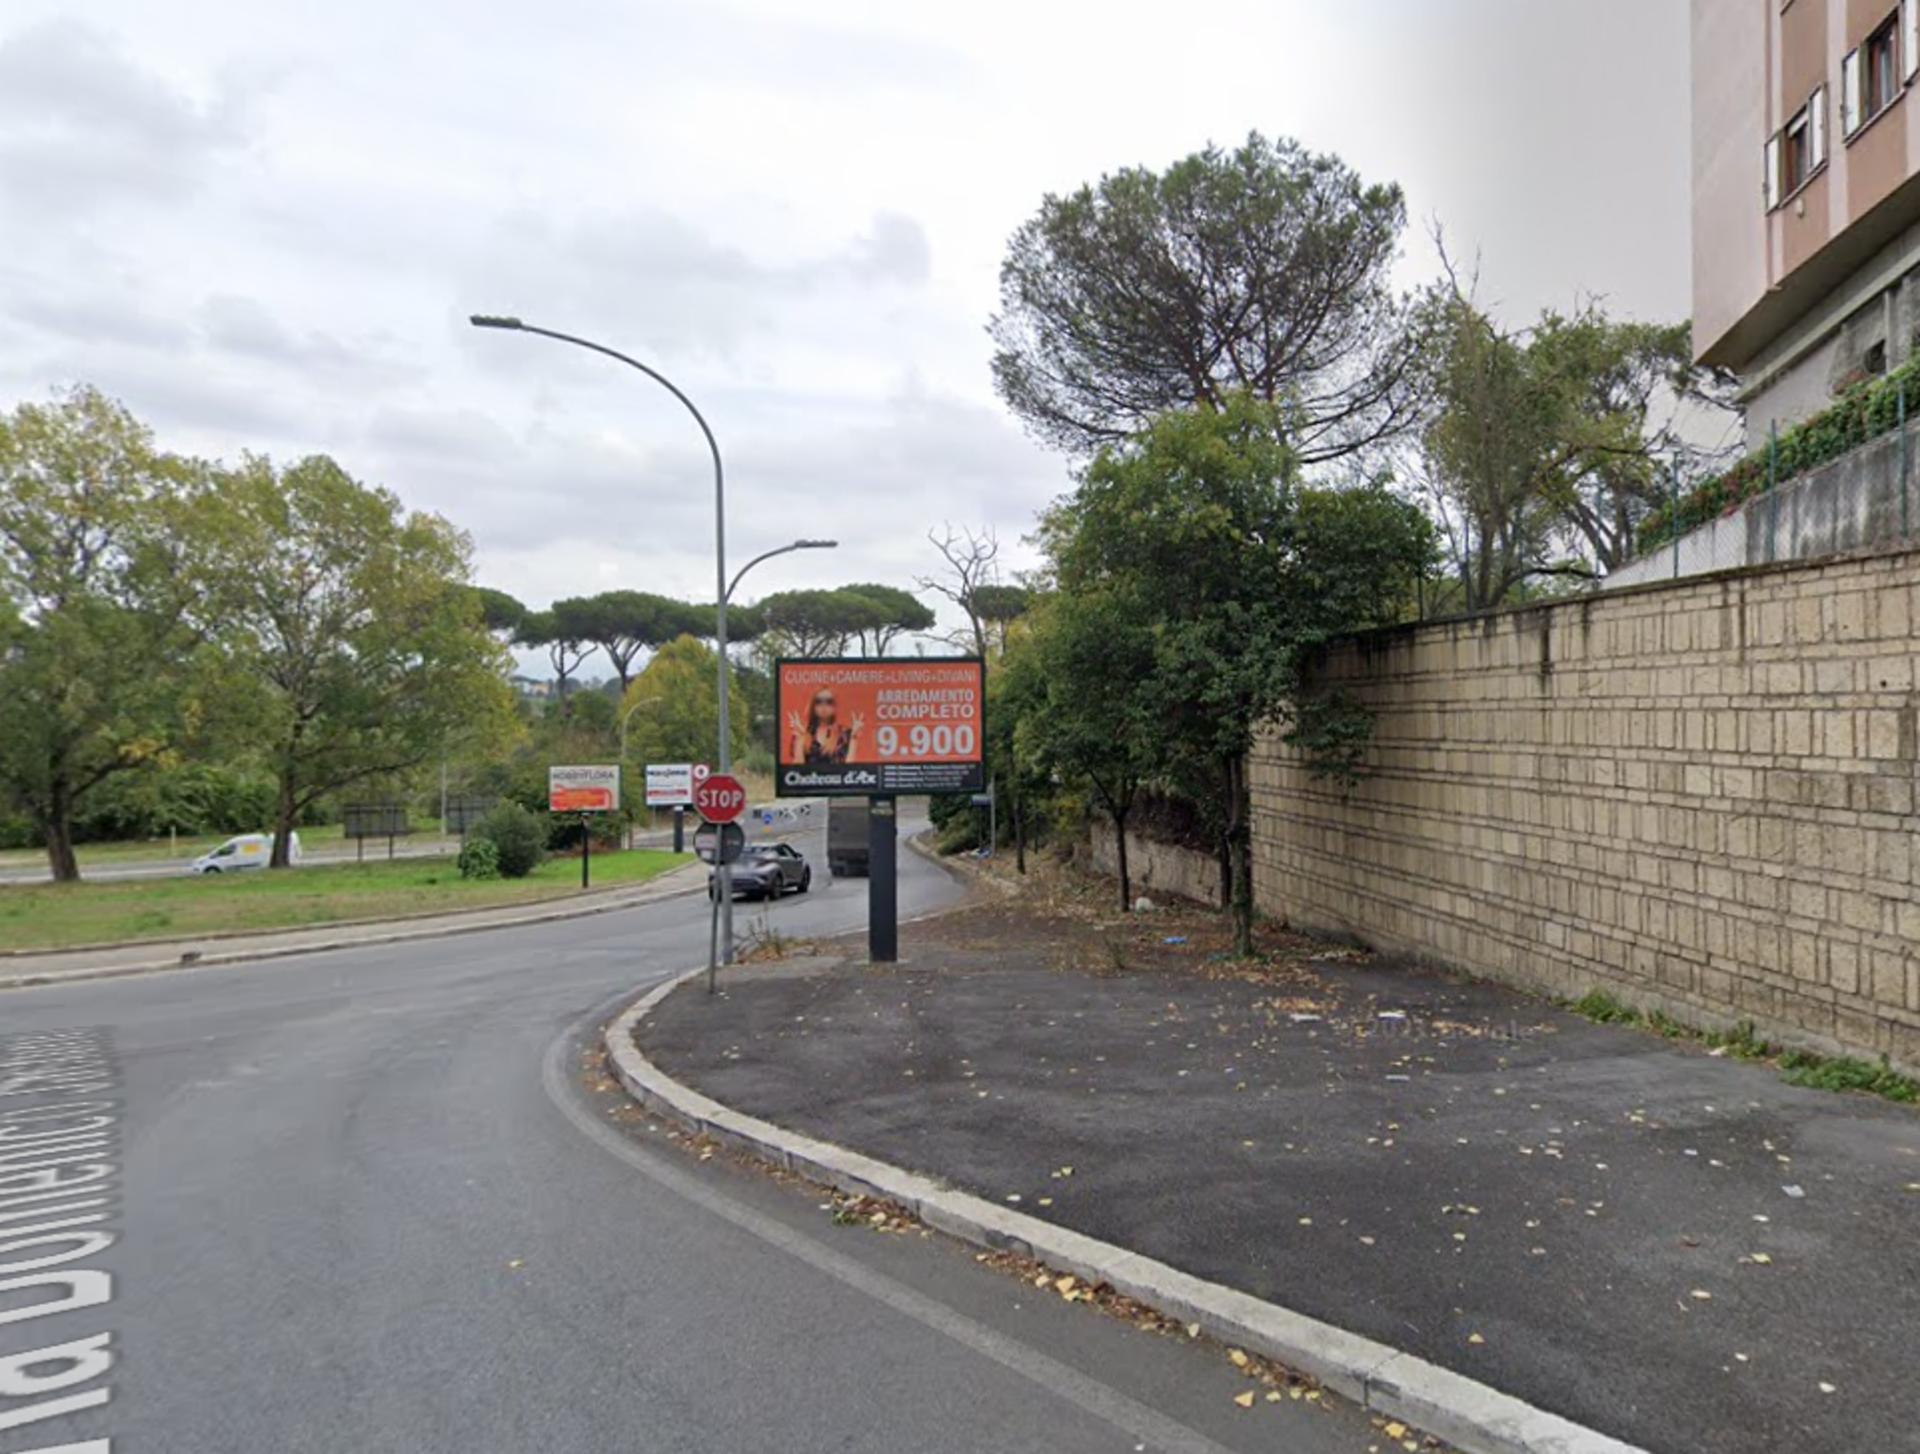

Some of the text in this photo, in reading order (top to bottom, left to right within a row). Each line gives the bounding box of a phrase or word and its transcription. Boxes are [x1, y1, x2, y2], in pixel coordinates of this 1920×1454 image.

[877, 689, 975, 703] ARREDAMENTO
[876, 703, 975, 719] COMPLETO
[877, 725, 975, 757] 9.900
[699, 789, 743, 808] STOP
